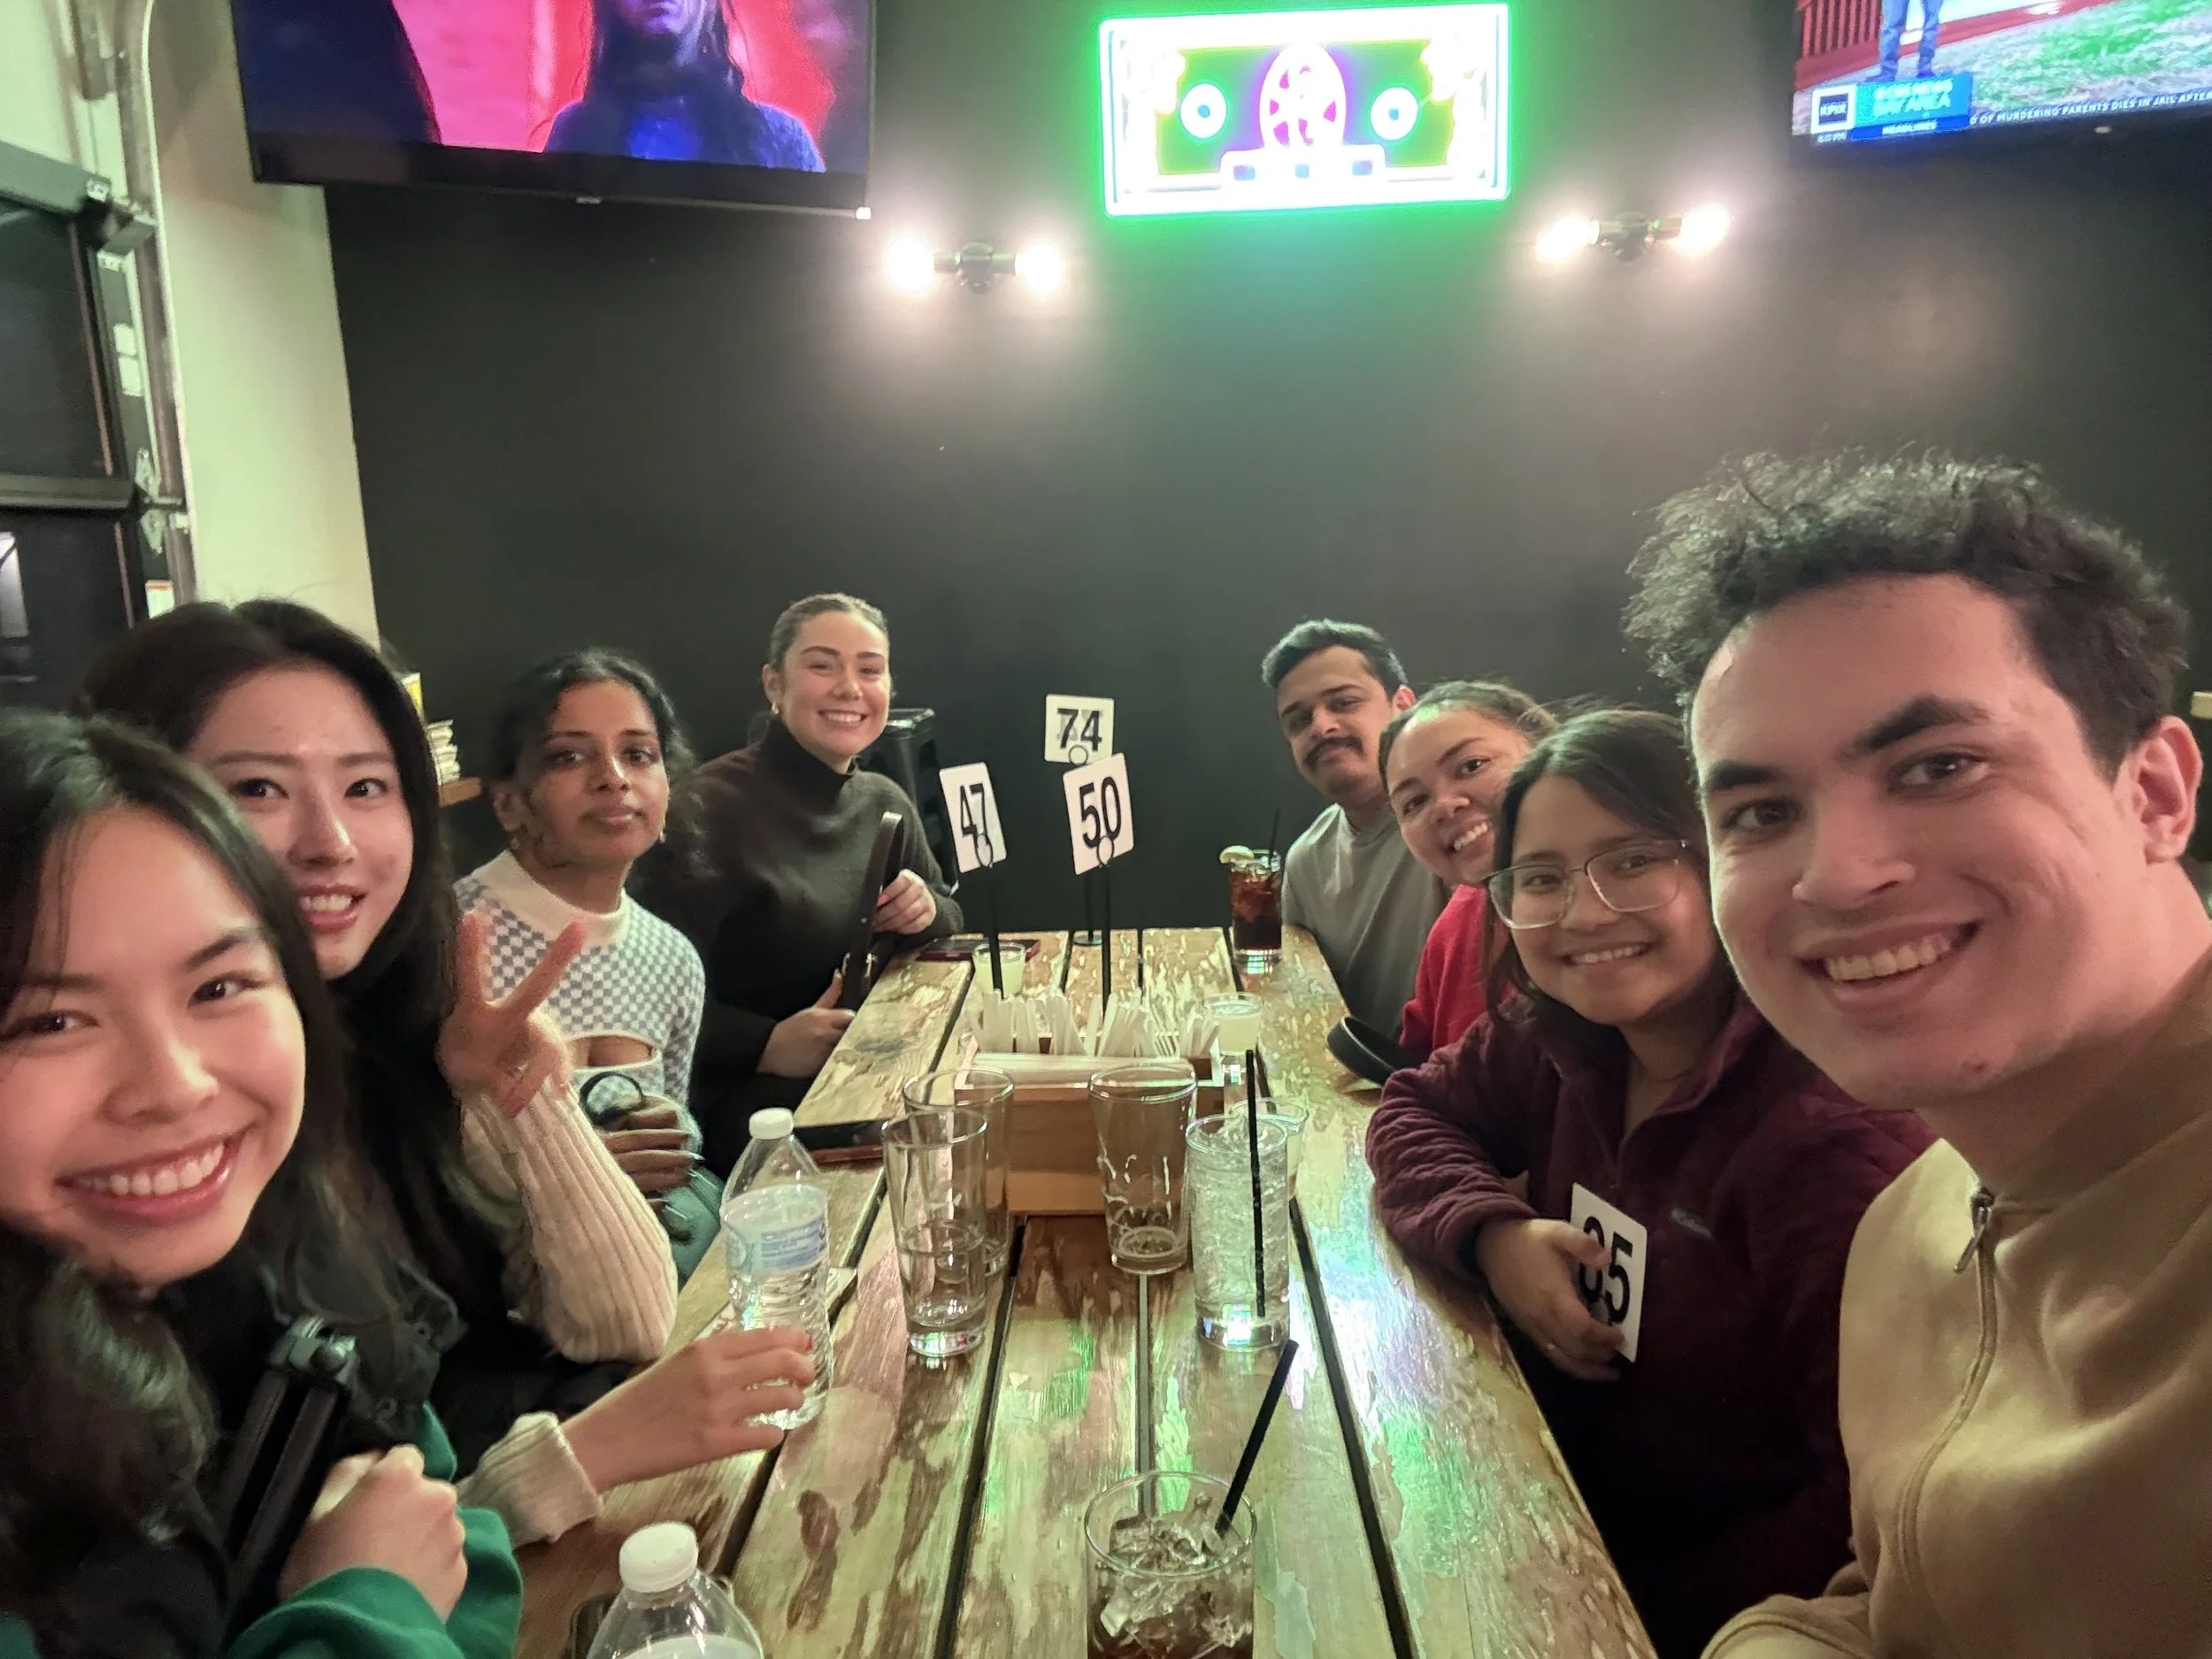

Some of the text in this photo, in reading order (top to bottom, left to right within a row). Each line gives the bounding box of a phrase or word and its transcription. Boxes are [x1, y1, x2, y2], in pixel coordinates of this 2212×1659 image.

[1979, 113, 1995, 124] OF
[1996, 107, 2060, 122] MURDERING
[2062, 102, 2108, 115] PARENTS
[2111, 99, 2136, 111] DIES
[2138, 97, 2150, 107] IN
[2153, 95, 2177, 106] JAIL
[1056, 708, 1102, 752] 74
[959, 782, 991, 849] 47
[1079, 776, 1122, 849] 50
